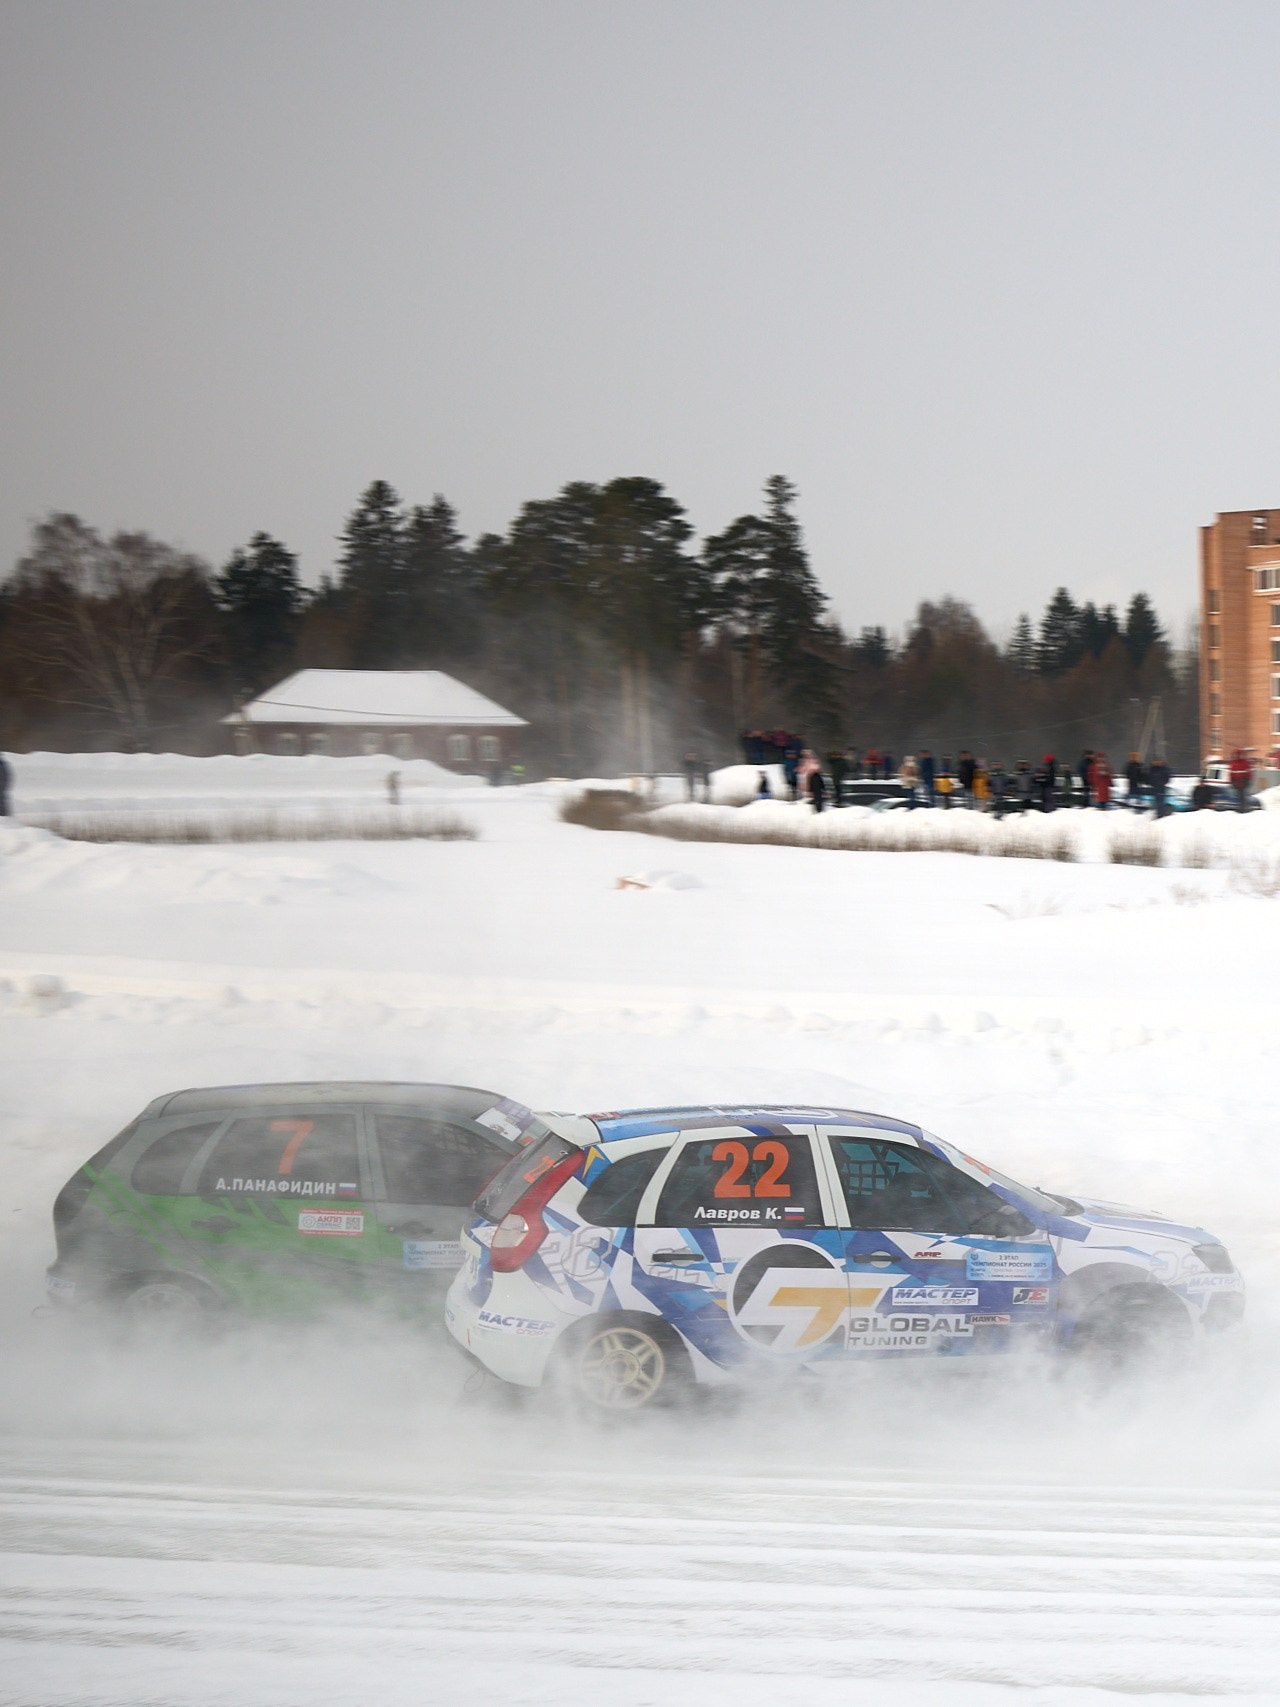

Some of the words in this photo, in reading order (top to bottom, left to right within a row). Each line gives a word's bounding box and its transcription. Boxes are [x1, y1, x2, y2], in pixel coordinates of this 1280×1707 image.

[269, 1120, 316, 1175] 7
[712, 1140, 791, 1198] 22
[215, 1178, 336, 1195] А.ПАНАФИДИН
[694, 1206, 760, 1221] Лавров
[765, 1207, 782, 1219] К.
[895, 1289, 977, 1298] МАСТЕР
[479, 1310, 557, 1331] МАСТЕР
[849, 1317, 969, 1333] GLOBAL
[849, 1336, 928, 1346] TUNING
